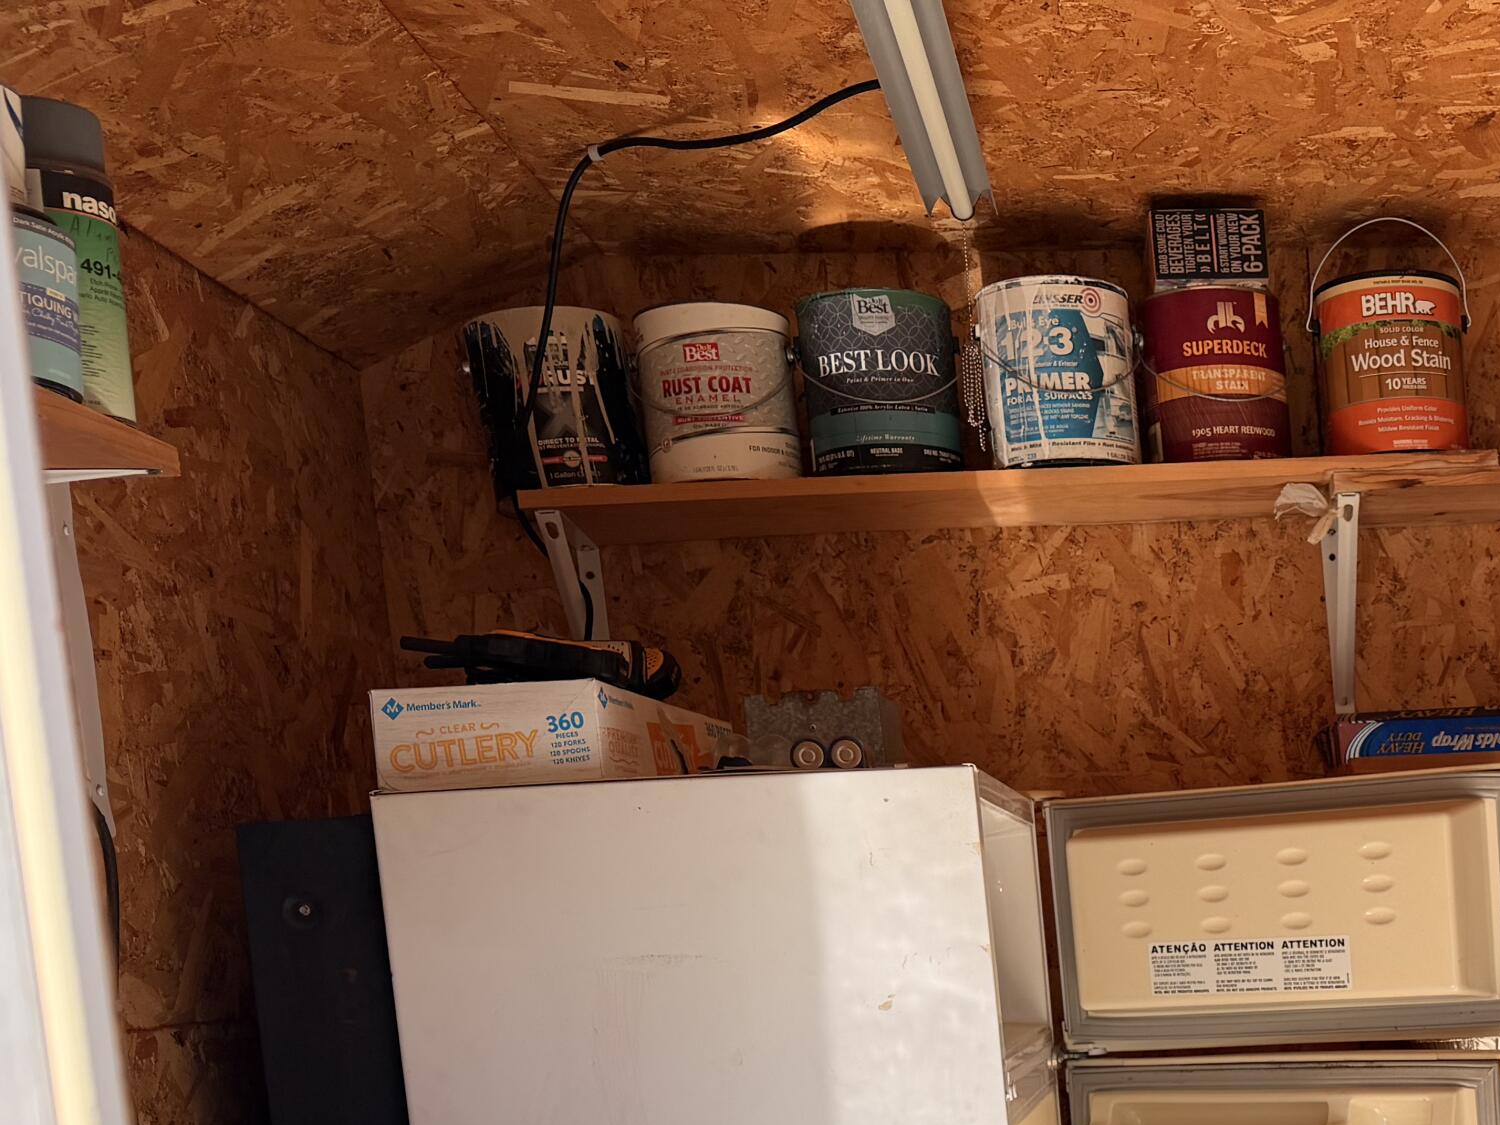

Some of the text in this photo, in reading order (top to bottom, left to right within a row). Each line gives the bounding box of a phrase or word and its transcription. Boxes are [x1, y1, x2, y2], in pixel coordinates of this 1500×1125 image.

[1216, 213, 1228, 246] WORKING
[1155, 213, 1169, 274] GRAB SOME COLD
[1181, 214, 1196, 274] TIGHTEN YOUR
[1226, 212, 1242, 273] ON YOUR NEW
[1239, 213, 1264, 273] 6-PACK
[1219, 246, 1230, 267] START
[858, 300, 889, 314] Best
[1361, 291, 1416, 318] BEHR
[1379, 325, 1424, 334] SOLID COLOR
[1182, 339, 1268, 359] SUPERDECK
[1364, 335, 1439, 349] House & Fence
[685, 346, 719, 361] Best
[1351, 348, 1451, 373] Wood Stain
[818, 349, 940, 378] BEST LOOK
[1192, 367, 1267, 382] TRANSPARENT
[662, 376, 752, 398] RUST COAT
[1215, 379, 1249, 391] STAIN
[1385, 377, 1427, 390] 10 YEARS
[675, 394, 740, 406] ENAMEL
[1044, 390, 1094, 401] SURFACES
[1377, 406, 1401, 414] Provides
[1192, 425, 1276, 439] 1905 HEART REDWOOD
[537, 437, 563, 446] DIRECT
[564, 436, 576, 444] TO
[406, 699, 479, 712] Member's Mark
[439, 722, 476, 736] CLEAR
[545, 711, 585, 734] 360
[555, 730, 579, 740] PIECES
[1387, 731, 1425, 742] DUTY
[1431, 731, 1475, 750] Wrap
[551, 738, 586, 748] 120 FORKS
[1377, 742, 1425, 755] HEAVY
[389, 728, 539, 774] CUTLERY
[549, 746, 591, 757] 120 SPOONS
[552, 754, 590, 765] 120 KNIVES
[1151, 941, 1207, 955] ATENÇÃO
[1213, 941, 1275, 952] ATTENTION
[1281, 938, 1345, 950] ATTENTION
